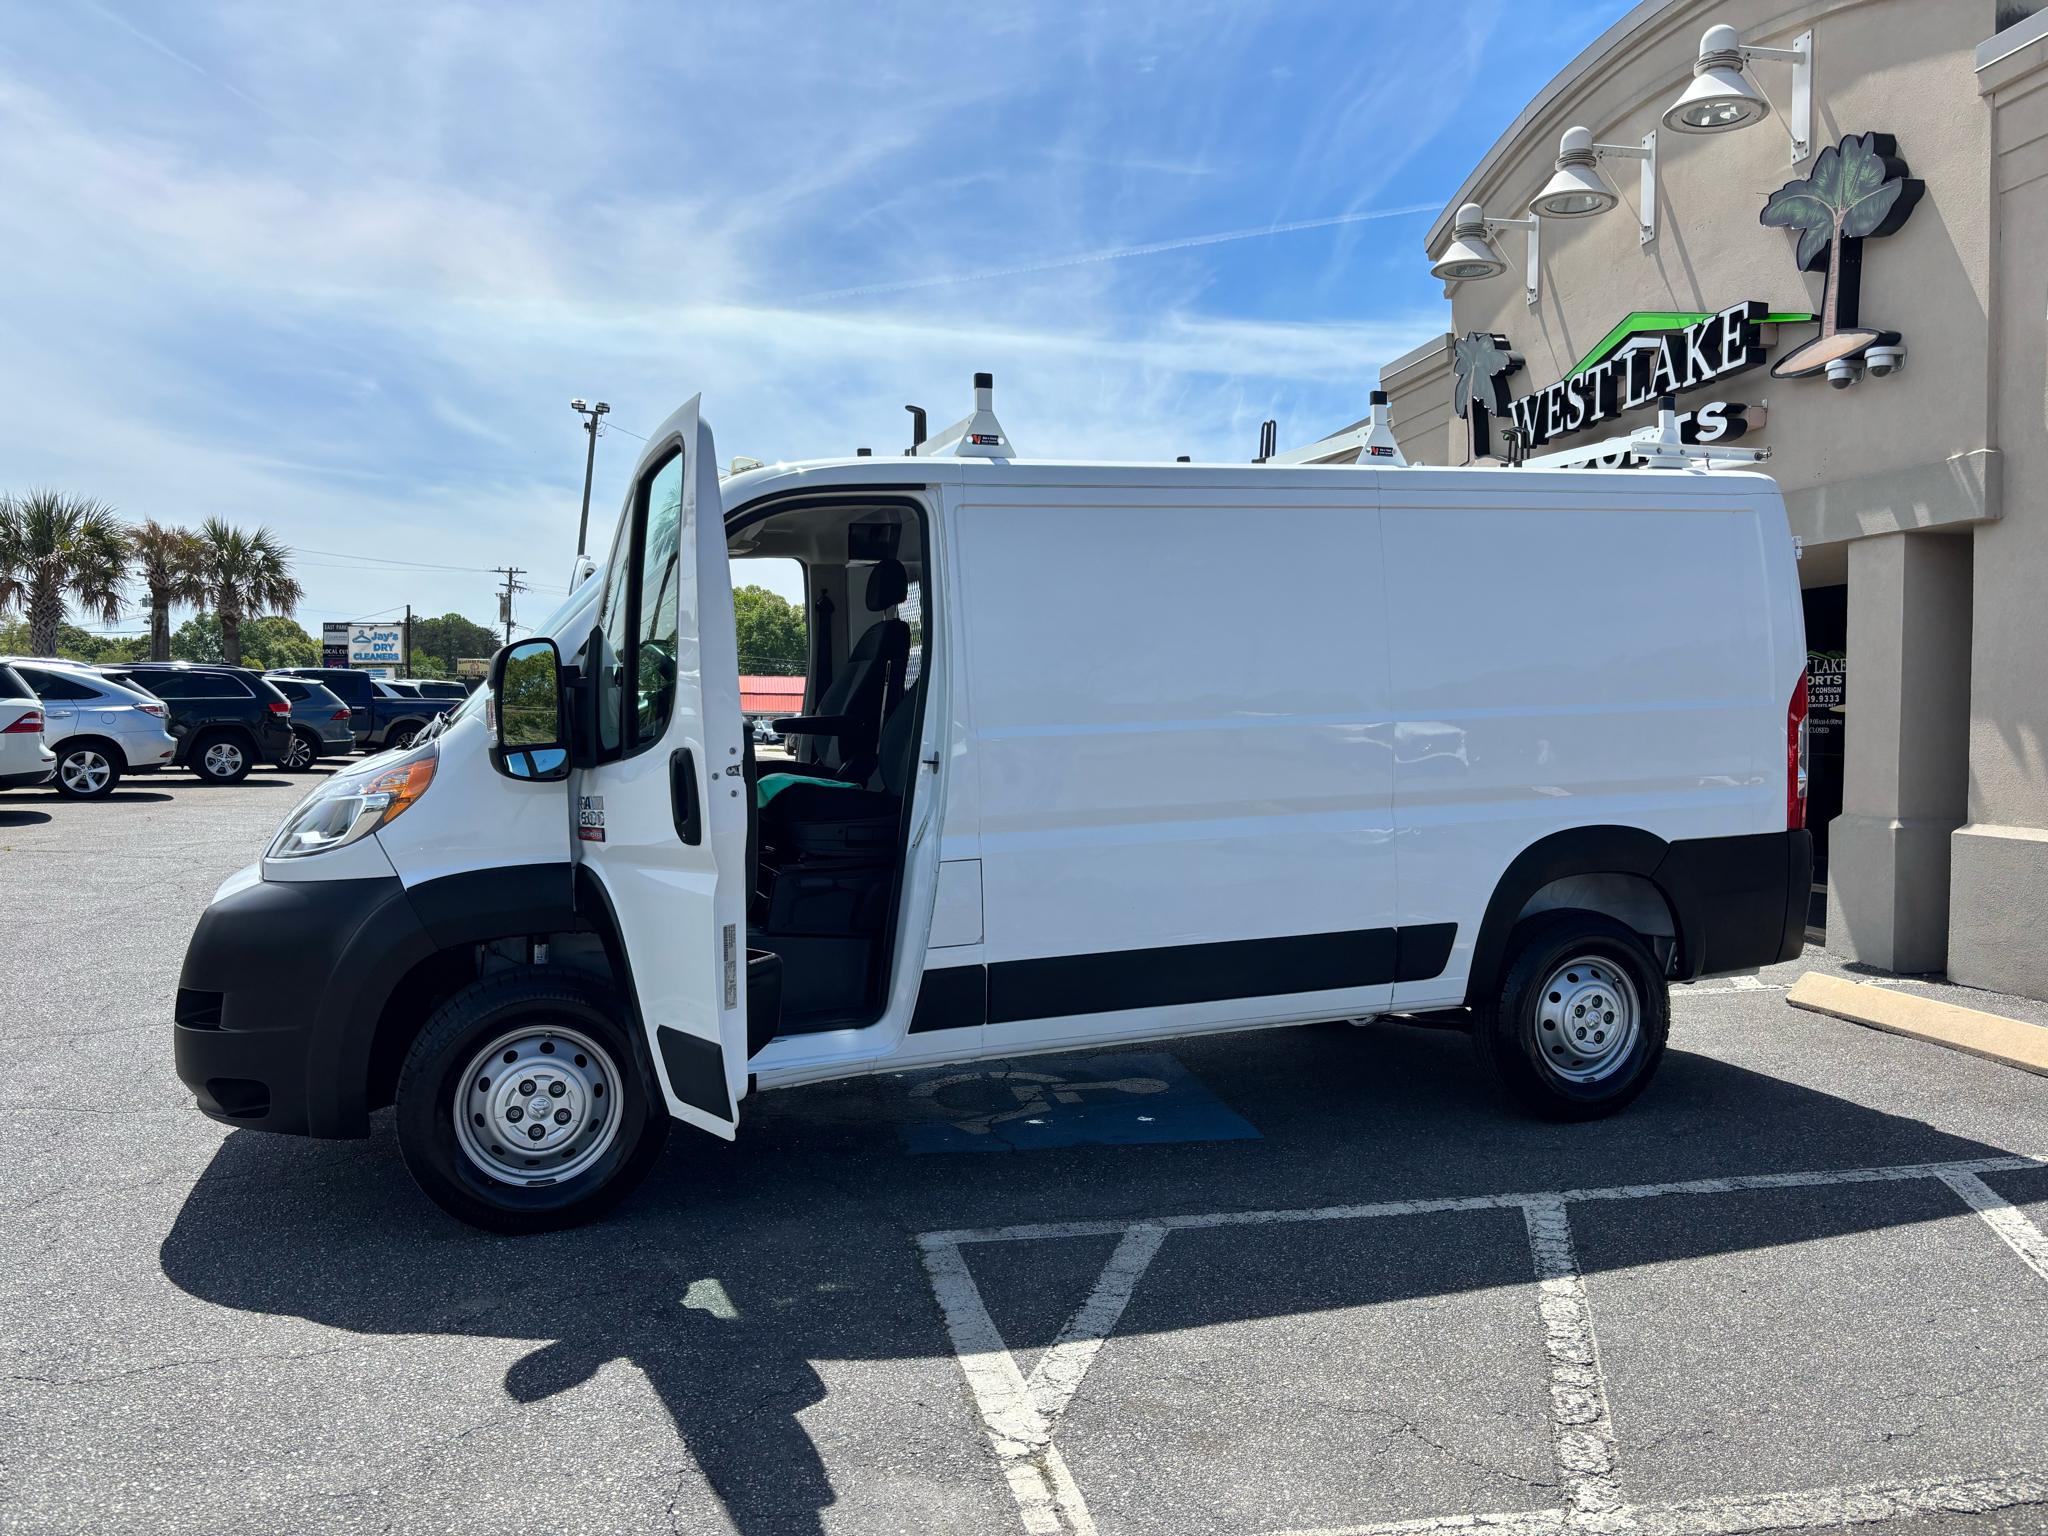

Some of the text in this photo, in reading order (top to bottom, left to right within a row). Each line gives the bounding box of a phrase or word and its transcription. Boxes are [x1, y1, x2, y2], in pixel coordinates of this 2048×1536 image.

[1507, 359, 1612, 446] WEST
[1621, 300, 1750, 411] LAKE
[371, 631, 399, 641] Jay's
[373, 643, 395, 651] DRY
[353, 653, 399, 661] CLEANERS
[1814, 658, 1847, 674] LAKE
[1815, 686, 1842, 694] CONSIGN
